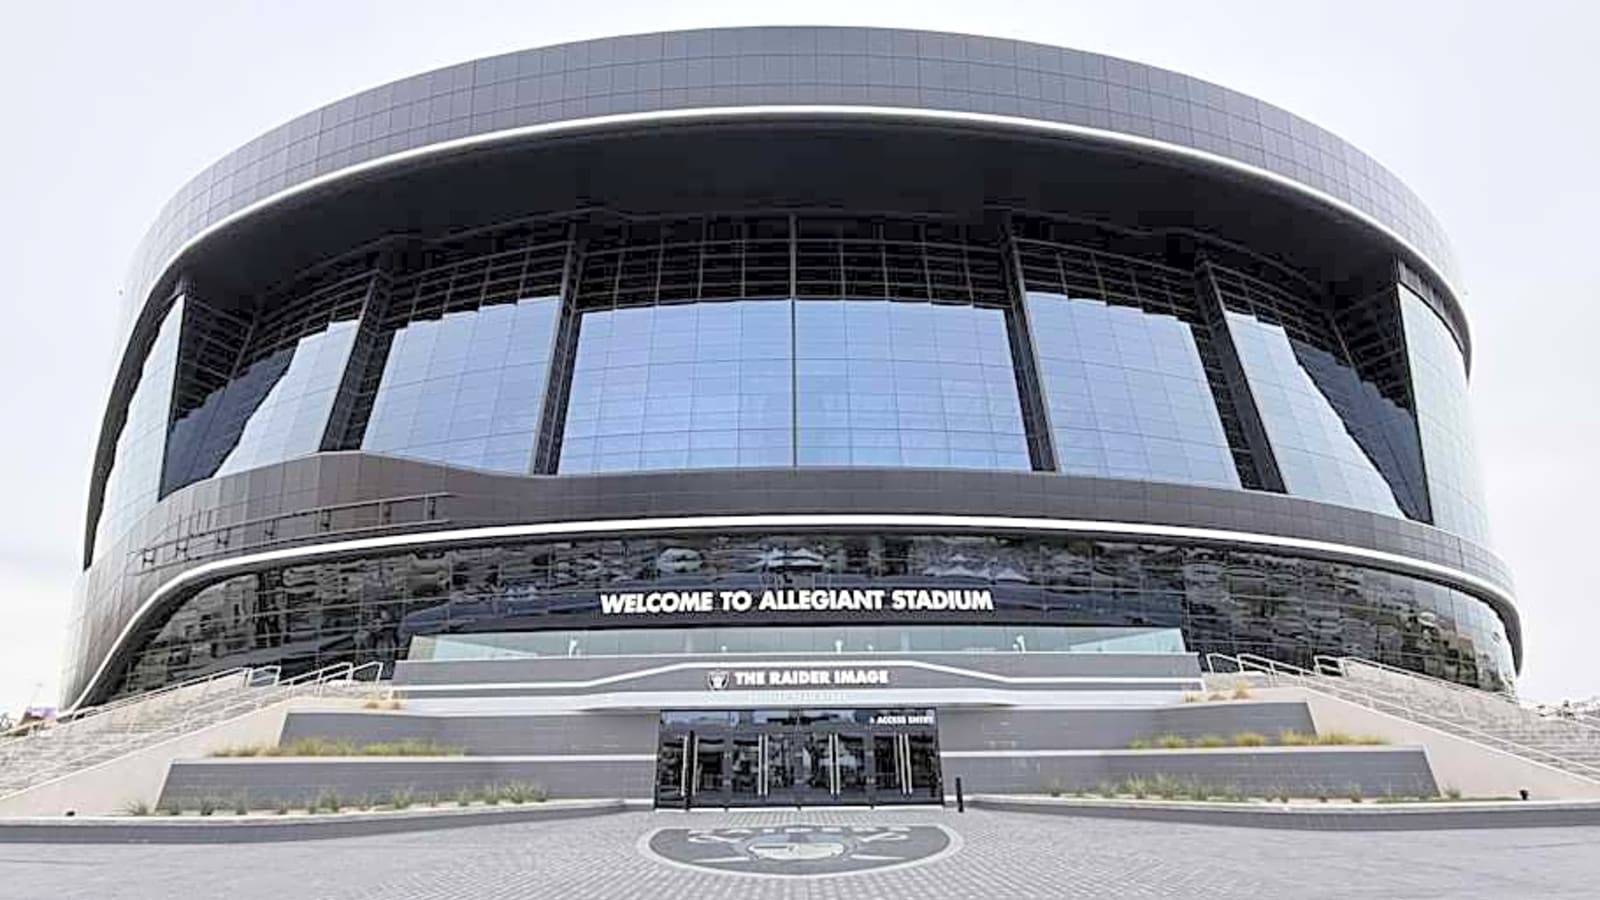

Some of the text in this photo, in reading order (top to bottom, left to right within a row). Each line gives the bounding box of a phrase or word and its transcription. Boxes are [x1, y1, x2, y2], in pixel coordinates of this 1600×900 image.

[601, 590, 993, 613] WELCOME TO ALLEGIANT STADIUM
[735, 670, 888, 685] THE RAIDER IMAGE
